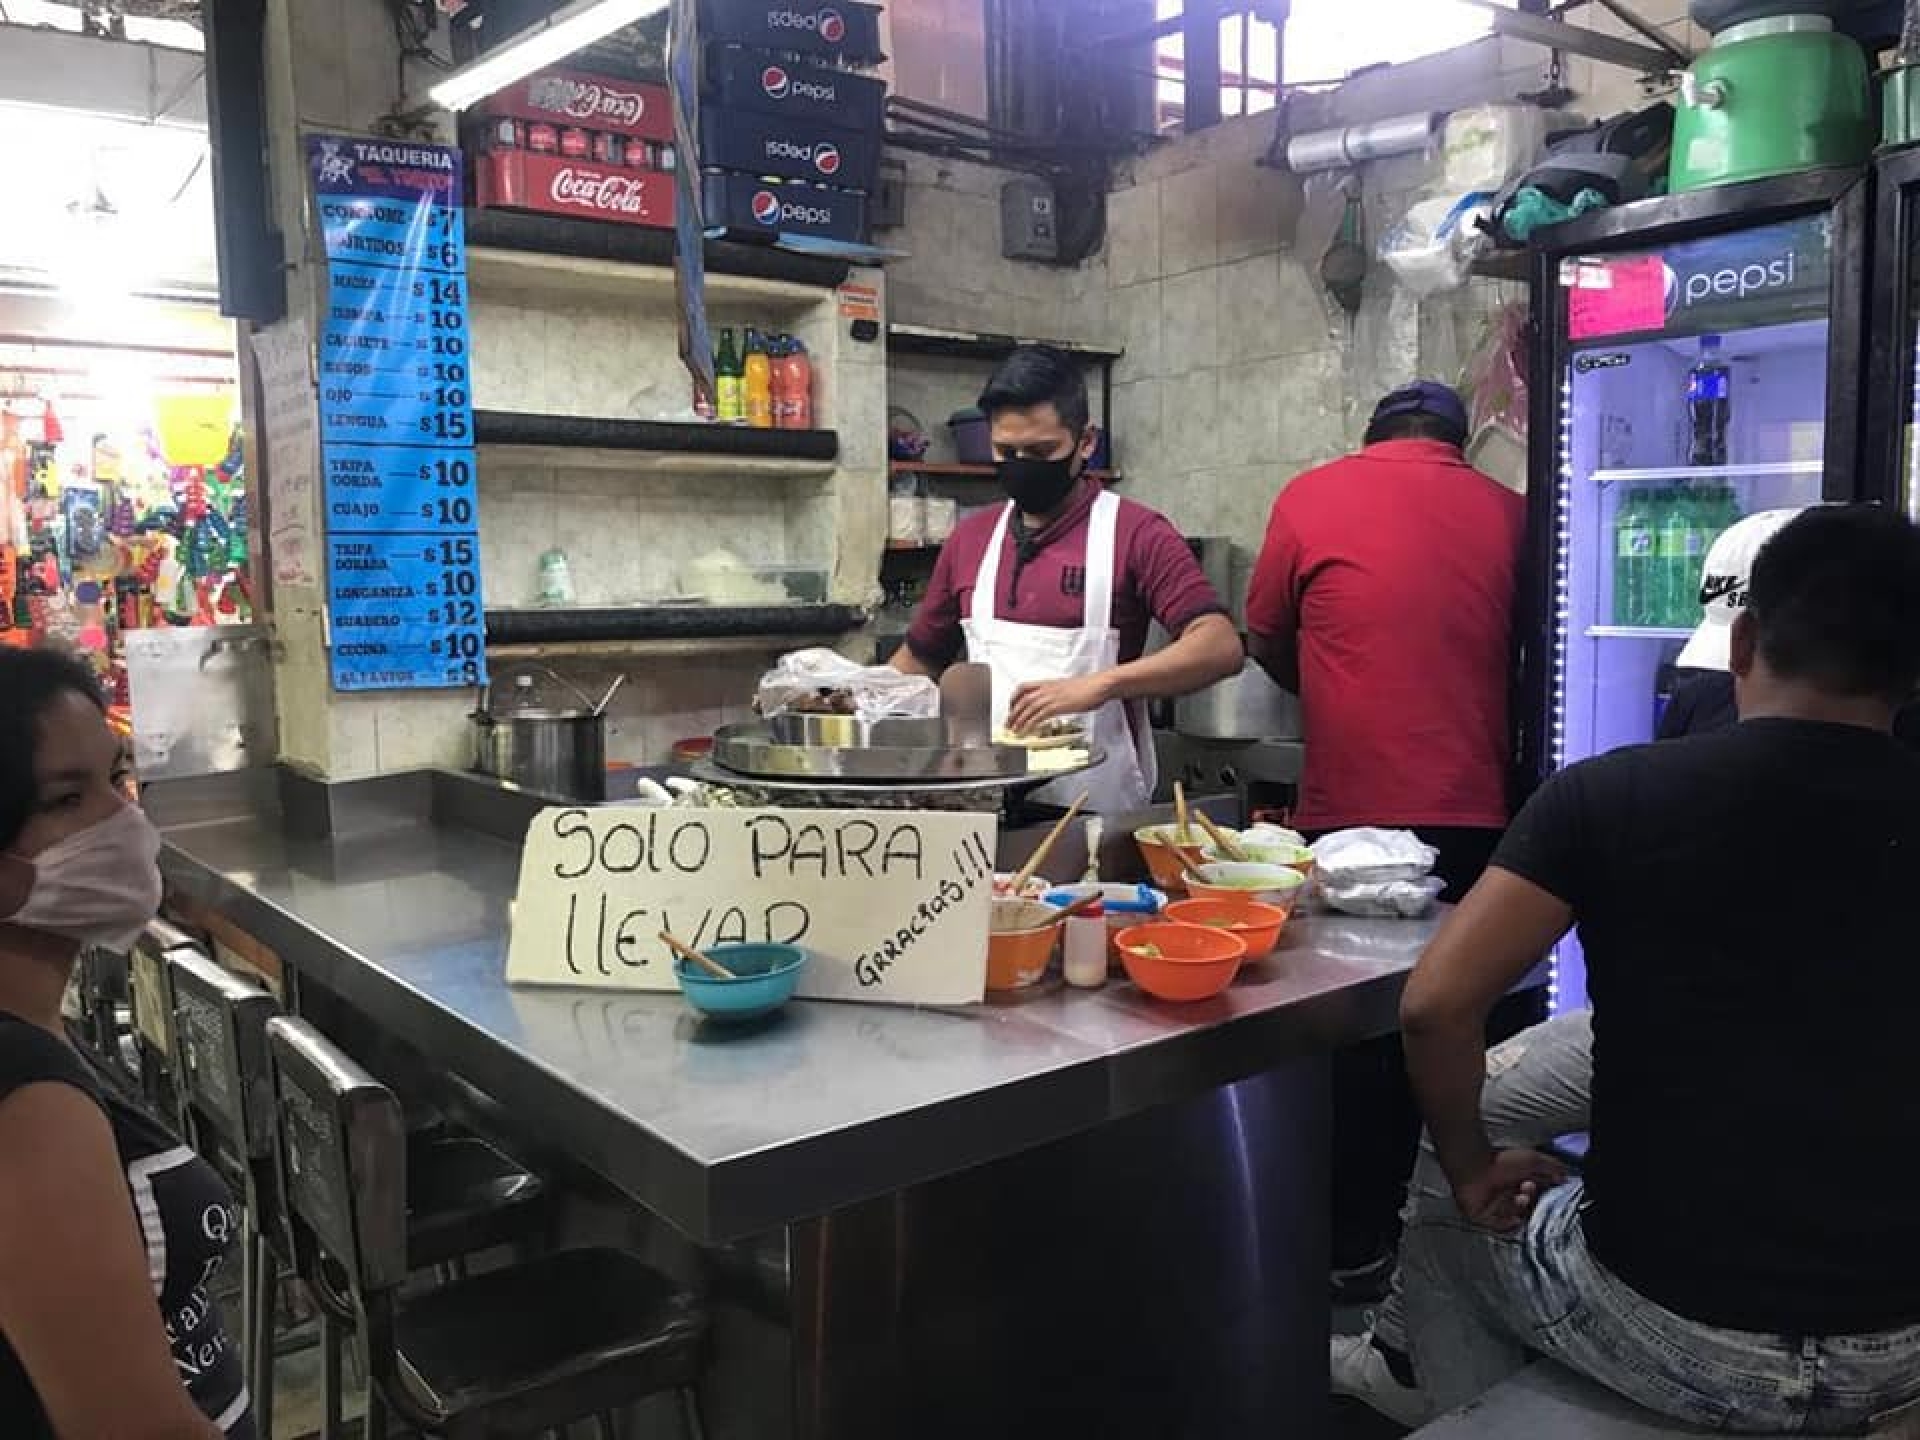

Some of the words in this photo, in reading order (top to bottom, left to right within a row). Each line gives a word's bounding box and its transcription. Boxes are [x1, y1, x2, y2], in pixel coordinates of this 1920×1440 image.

[768, 10, 815, 31] pepsi
[528, 77, 643, 126] Coca-Co
[791, 79, 835, 102] pepsi
[353, 144, 453, 169] TAQUERIA
[765, 139, 811, 160] pepsi
[552, 168, 644, 213] Coca-Cola
[781, 202, 832, 227] pepsi
[1685, 252, 1795, 305] pepsi
[744, 814, 923, 879] PARA
